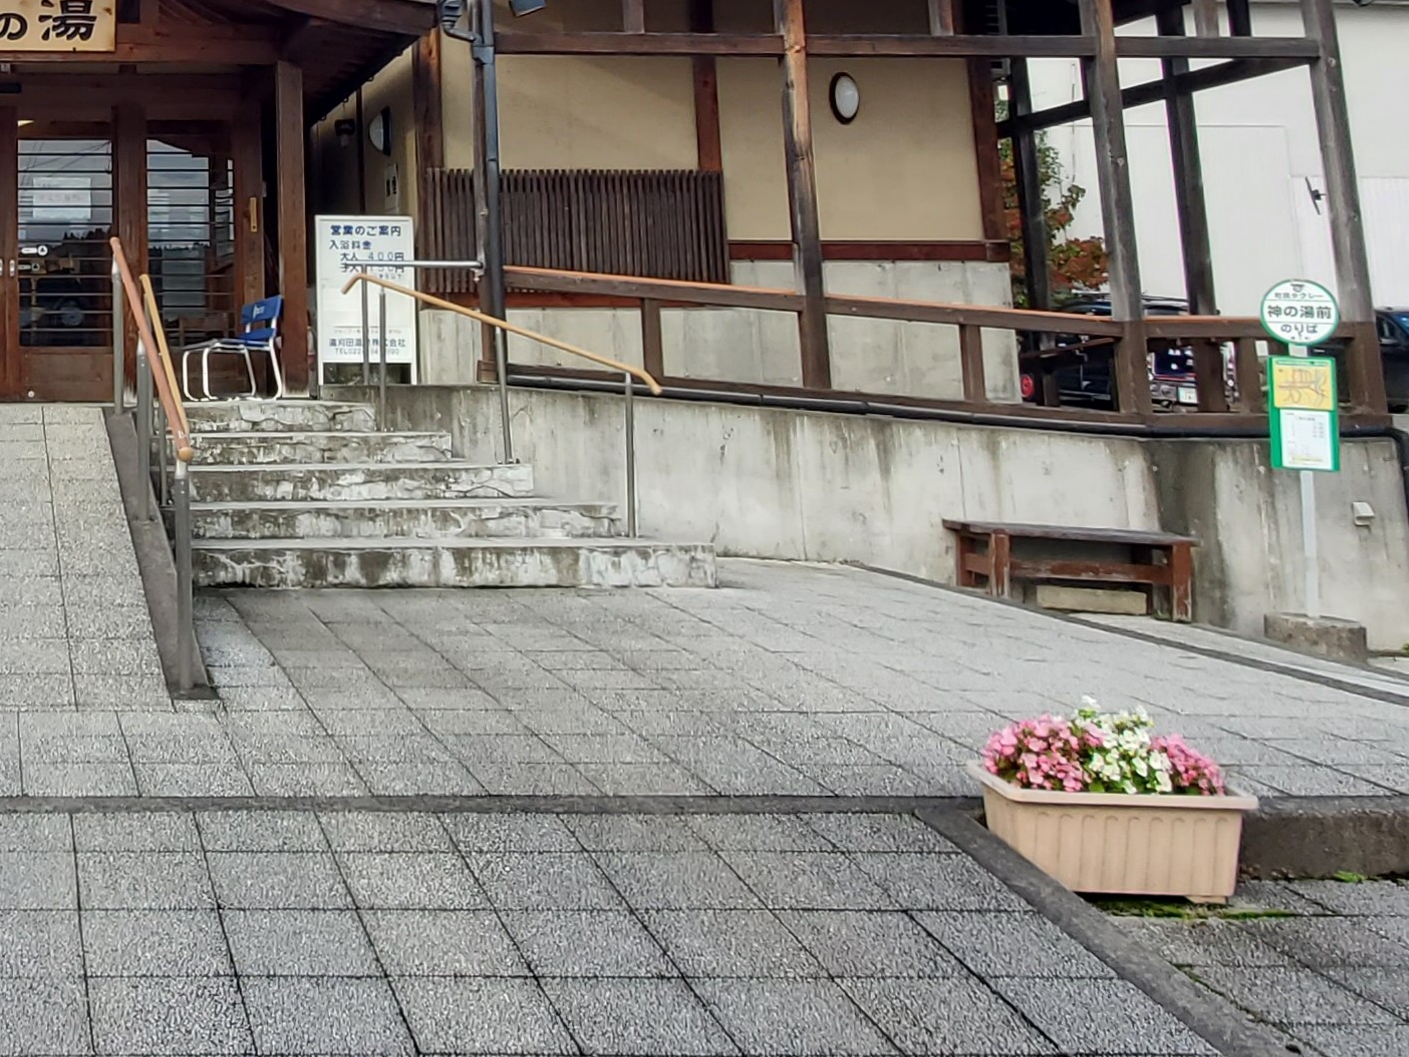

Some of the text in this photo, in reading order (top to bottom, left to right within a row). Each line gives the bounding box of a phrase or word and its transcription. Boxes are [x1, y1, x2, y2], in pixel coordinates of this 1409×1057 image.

[330, 225, 401, 236] 営業のご案内
[329, 240, 372, 250] 入浴料金
[340, 252, 359, 261] 大人
[1267, 304, 1332, 319] 神の湯前
[1280, 323, 1318, 335] のりば
